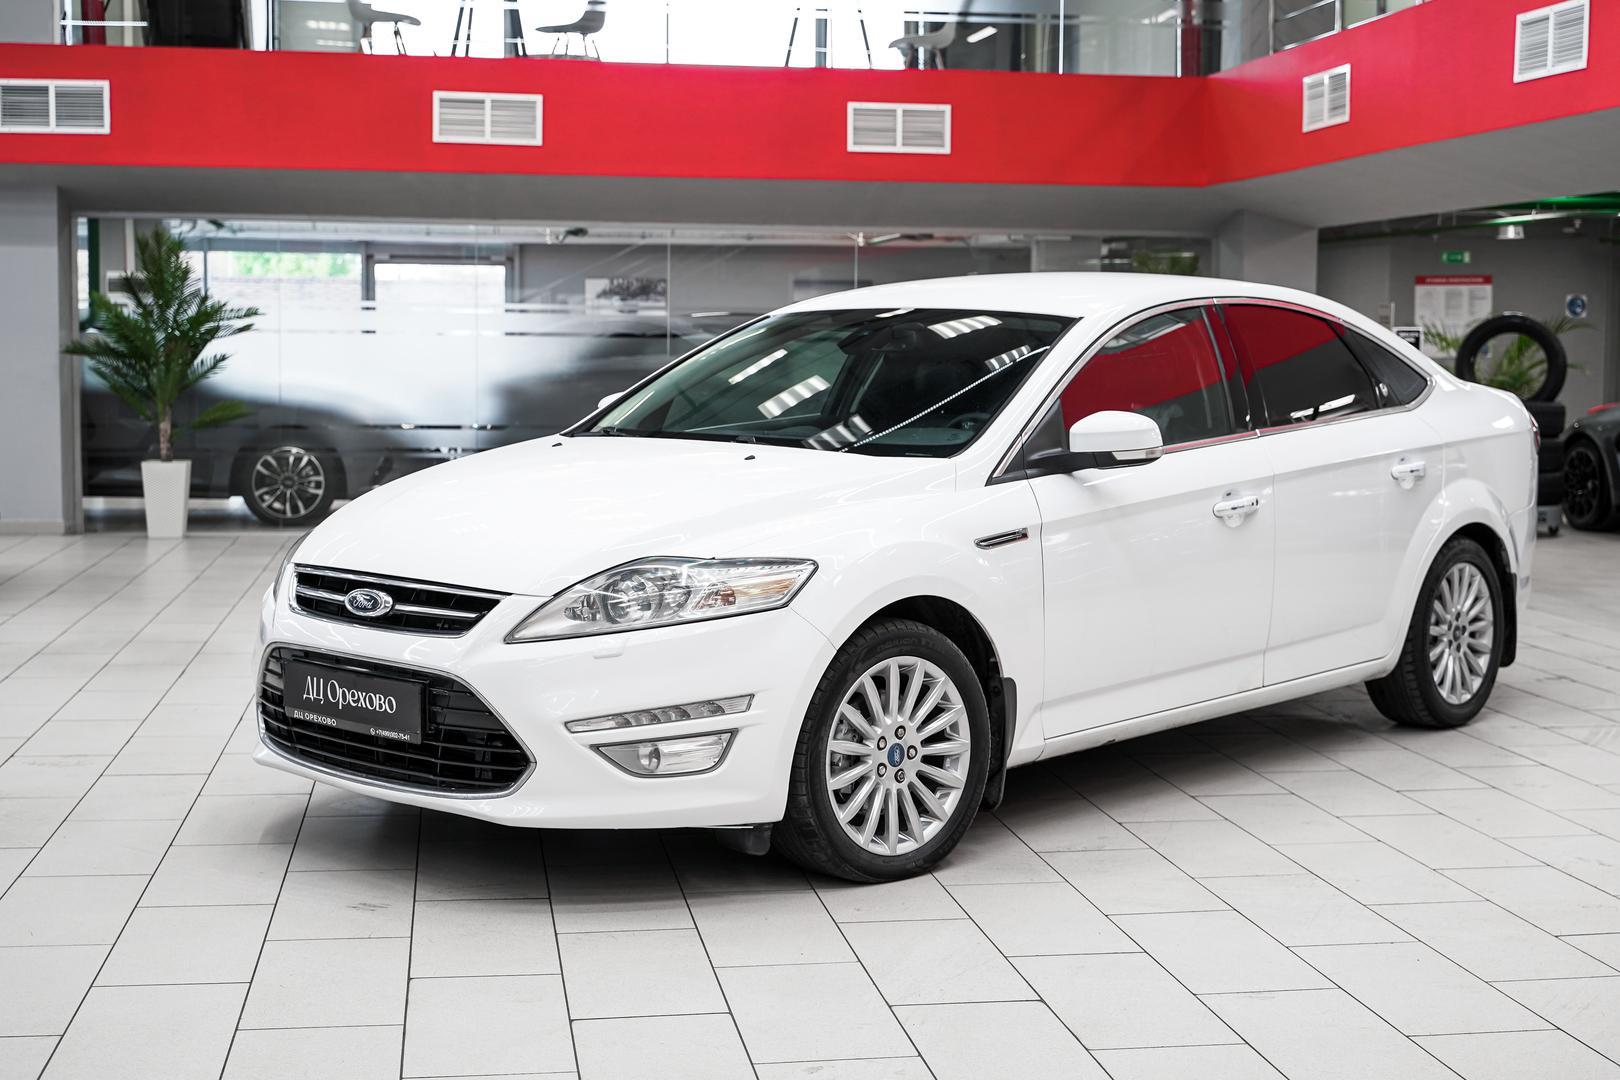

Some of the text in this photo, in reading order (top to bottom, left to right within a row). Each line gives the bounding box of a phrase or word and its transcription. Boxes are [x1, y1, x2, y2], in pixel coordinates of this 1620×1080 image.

[352, 590, 375, 609] Ford
[303, 675, 396, 714] ДЦ Орехово
[294, 710, 337, 726] ДЦ ОРЕХОВО
